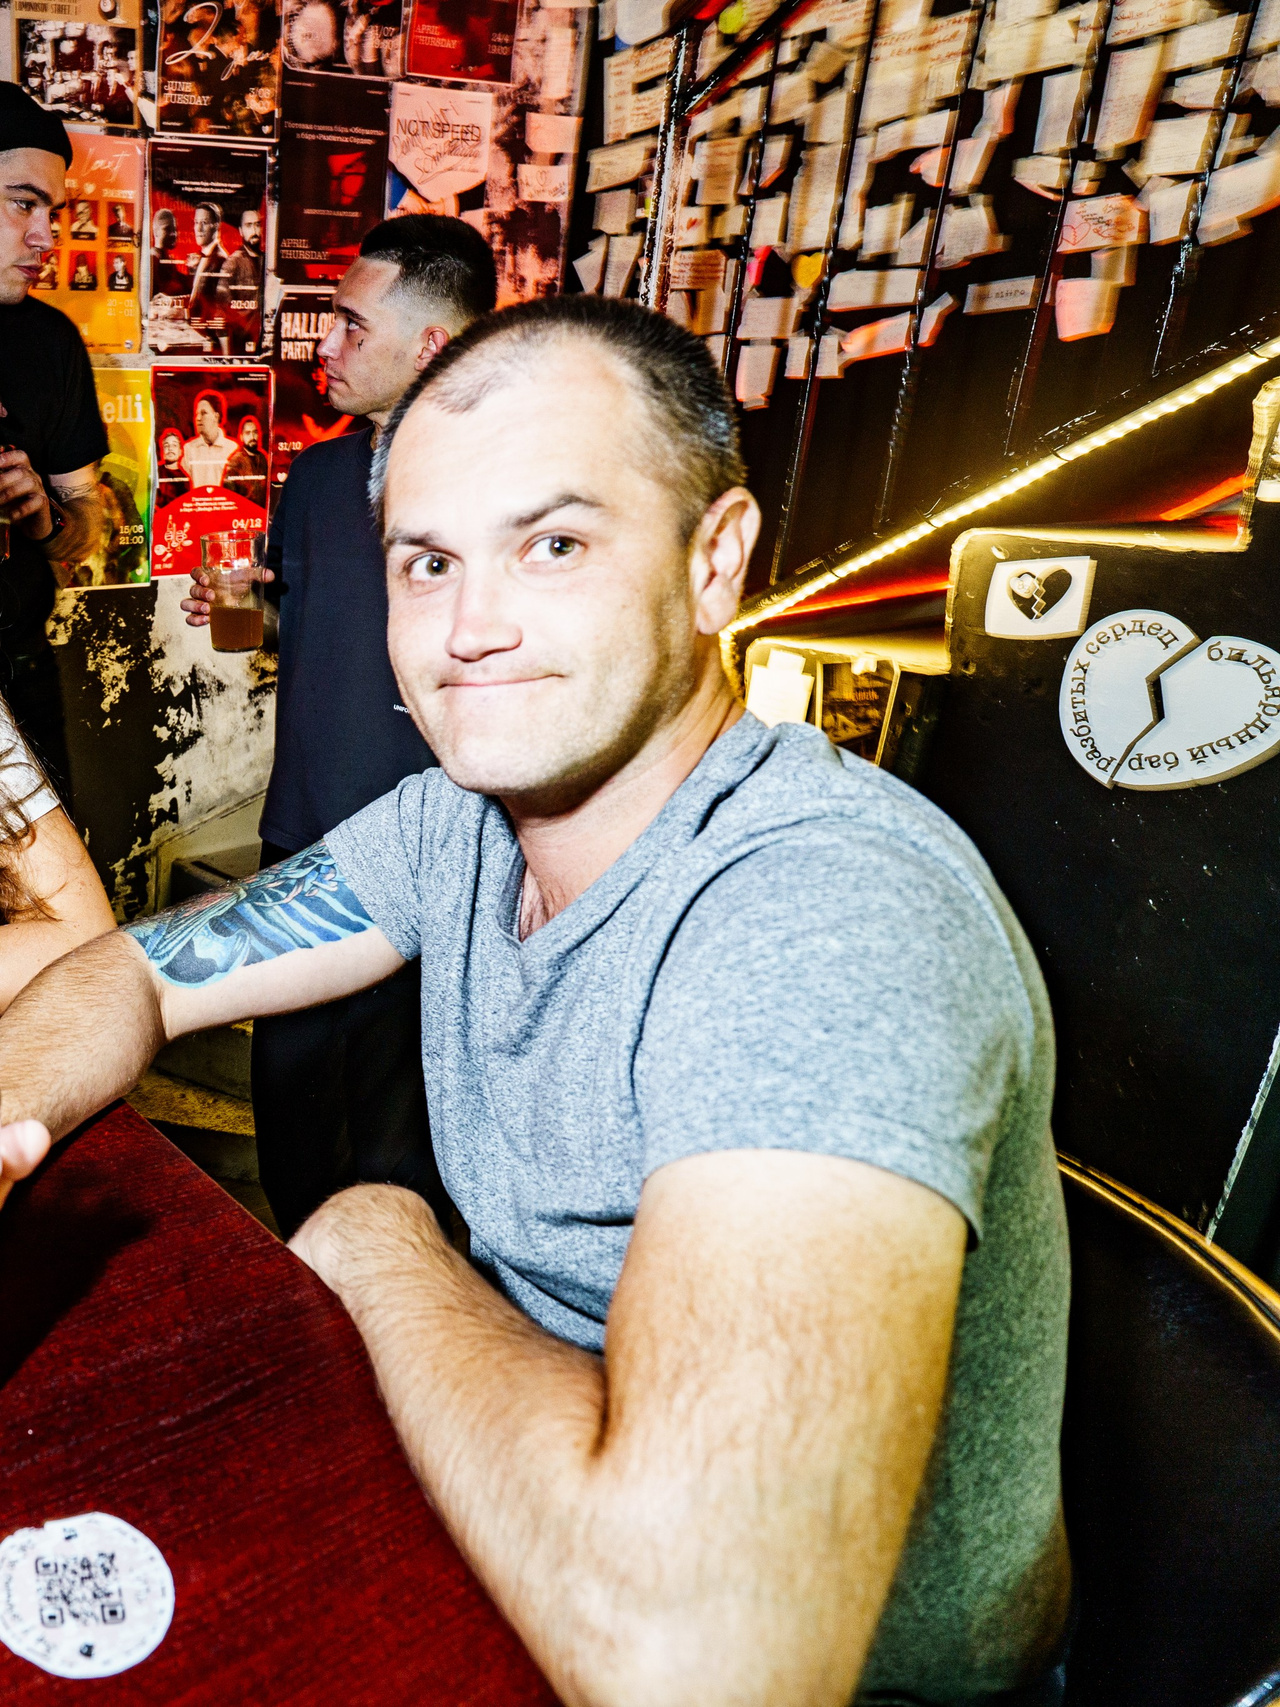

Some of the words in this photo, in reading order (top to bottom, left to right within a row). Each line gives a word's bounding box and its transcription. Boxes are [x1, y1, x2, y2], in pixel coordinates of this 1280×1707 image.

[416, 24, 440, 35] APRIL
[415, 35, 458, 49] THURSDAY
[164, 81, 193, 92] JUNE
[164, 93, 211, 106] TUESDAY
[397, 118, 428, 137] NOT
[281, 238, 309, 249] APRIL
[281, 249, 329, 260] THURSDAY
[281, 341, 315, 361] PARTY
[103, 393, 145, 423] elli
[278, 441, 302, 451] 31/10
[119, 525, 144, 535] 15/08
[232, 518, 262, 530] 04/12
[119, 536, 144, 545] 21:00
[1085, 619, 1179, 655] сердец
[1186, 640, 1280, 765] бильярдный
[1069, 658, 1117, 772] разбитых
[1128, 751, 1180, 772] бар
